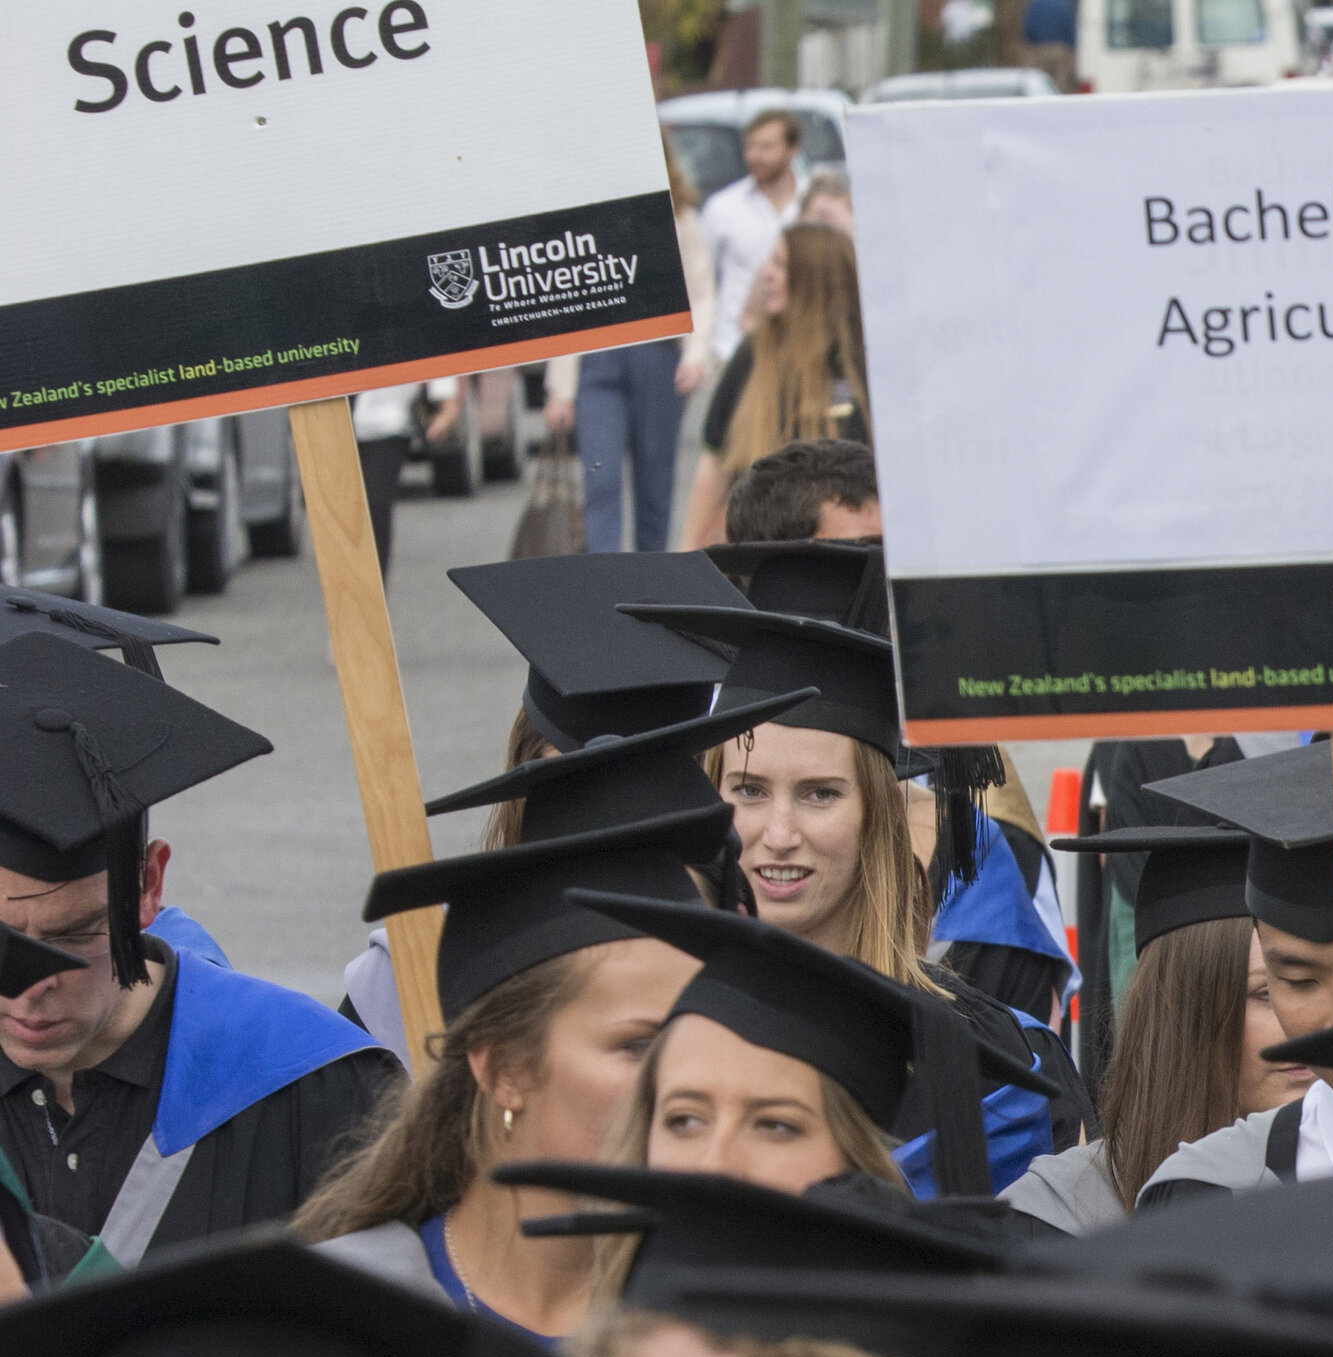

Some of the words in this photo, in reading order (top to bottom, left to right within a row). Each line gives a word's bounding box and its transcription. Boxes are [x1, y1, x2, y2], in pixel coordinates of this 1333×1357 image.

[67, 0, 431, 113] Science
[478, 230, 597, 275] Lincoln
[483, 254, 638, 302] University
[489, 303, 501, 312] Te
[581, 288, 589, 297] o
[585, 296, 627, 310] ZEALAND
[11, 381, 94, 408] Zealand's
[96, 367, 175, 397] specialist
[178, 349, 274, 380] land-based
[277, 336, 361, 364] university
[958, 677, 1005, 697] New
[1007, 672, 1105, 696] Zealand's
[1109, 668, 1206, 695] specialist
[1209, 663, 1325, 688] land-based
